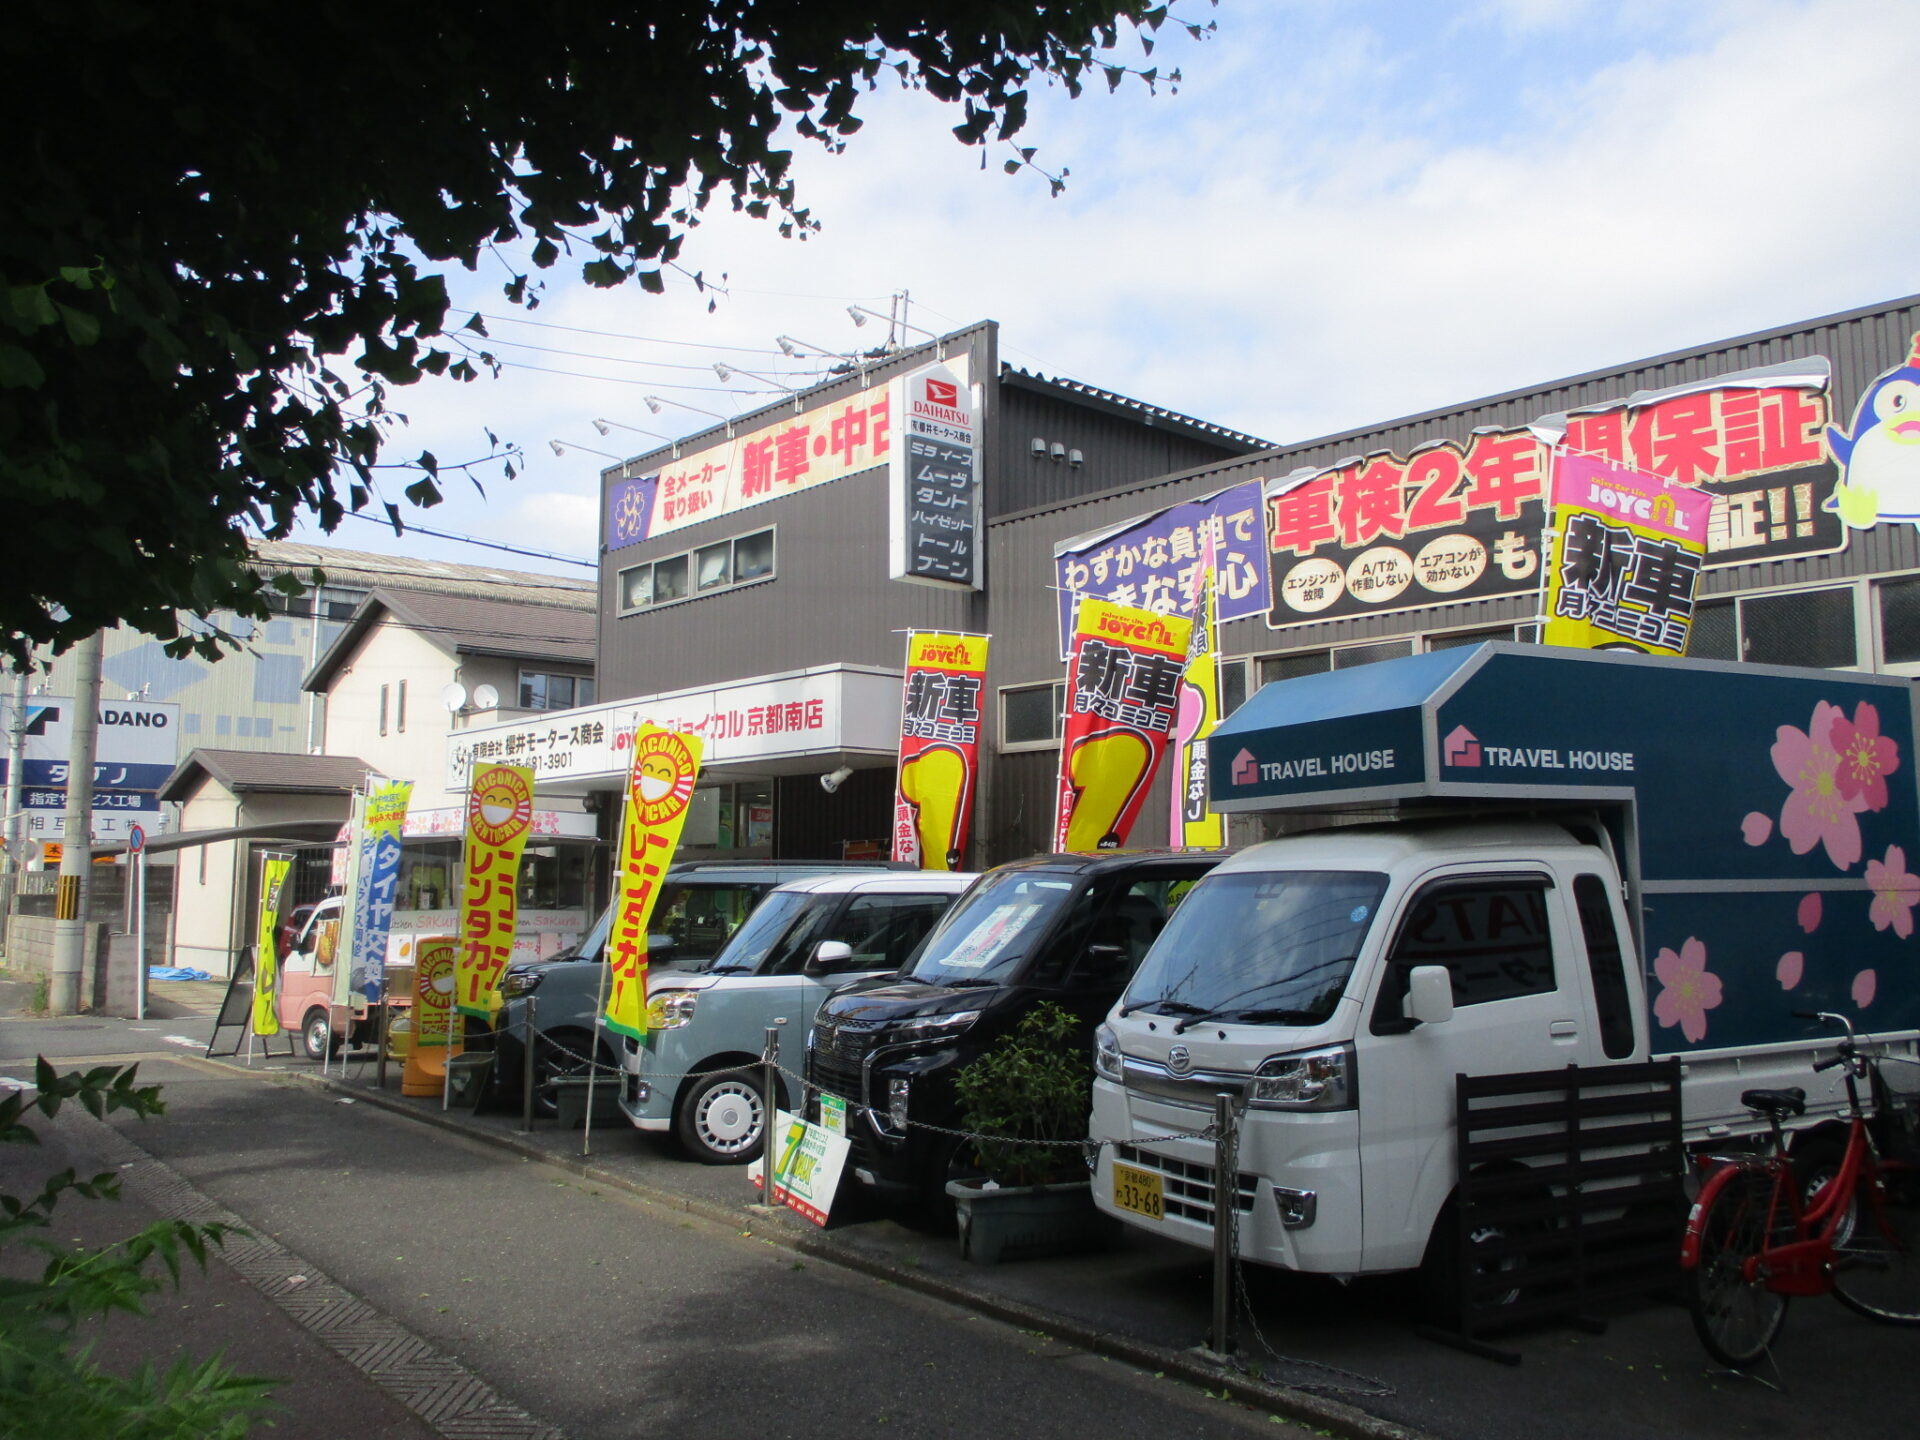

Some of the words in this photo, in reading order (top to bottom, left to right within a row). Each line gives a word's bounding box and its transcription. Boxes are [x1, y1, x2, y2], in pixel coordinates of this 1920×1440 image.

[914, 401, 969, 426] DAIHATSU
[663, 461, 726, 498] 全メーカー
[917, 465, 967, 489] ムーヴ
[663, 490, 714, 522] 取り扱い
[916, 487, 969, 509] タント
[1587, 484, 1690, 532] JOYCAL
[912, 510, 973, 532] ハイゼット
[919, 533, 967, 555] トール
[1065, 508, 1257, 589] わずかな負担で
[917, 555, 968, 578] ブーン
[1362, 559, 1398, 577] A/Tが
[1420, 548, 1482, 569] エアコンが
[1562, 513, 1702, 619] 新車
[1074, 551, 1259, 617] きな安心
[1287, 572, 1341, 591] エンジンが
[1351, 573, 1410, 592] 作動しない
[1426, 564, 1476, 583] 効かない
[1303, 587, 1325, 602] 故障
[1097, 616, 1175, 647] JOYCAL
[919, 644, 971, 665] JOYCAL
[1076, 640, 1183, 710] 新車
[904, 670, 981, 724] 新車
[97, 710, 168, 728] DANO
[472, 740, 502, 758] 有限会社
[1484, 747, 1564, 769] TRAVEL
[1569, 750, 1634, 771] HOUSE
[49, 765, 127, 785] タノ
[1260, 758, 1327, 781] TRAVEL
[1331, 749, 1394, 774] HOUSE
[475, 770, 528, 801] NICONICO
[30, 792, 142, 808] 指定サビス工場
[362, 843, 401, 986] タイヤ交換
[462, 845, 493, 1002] レンタカー
[1124, 1184, 1159, 1215] 33-68
